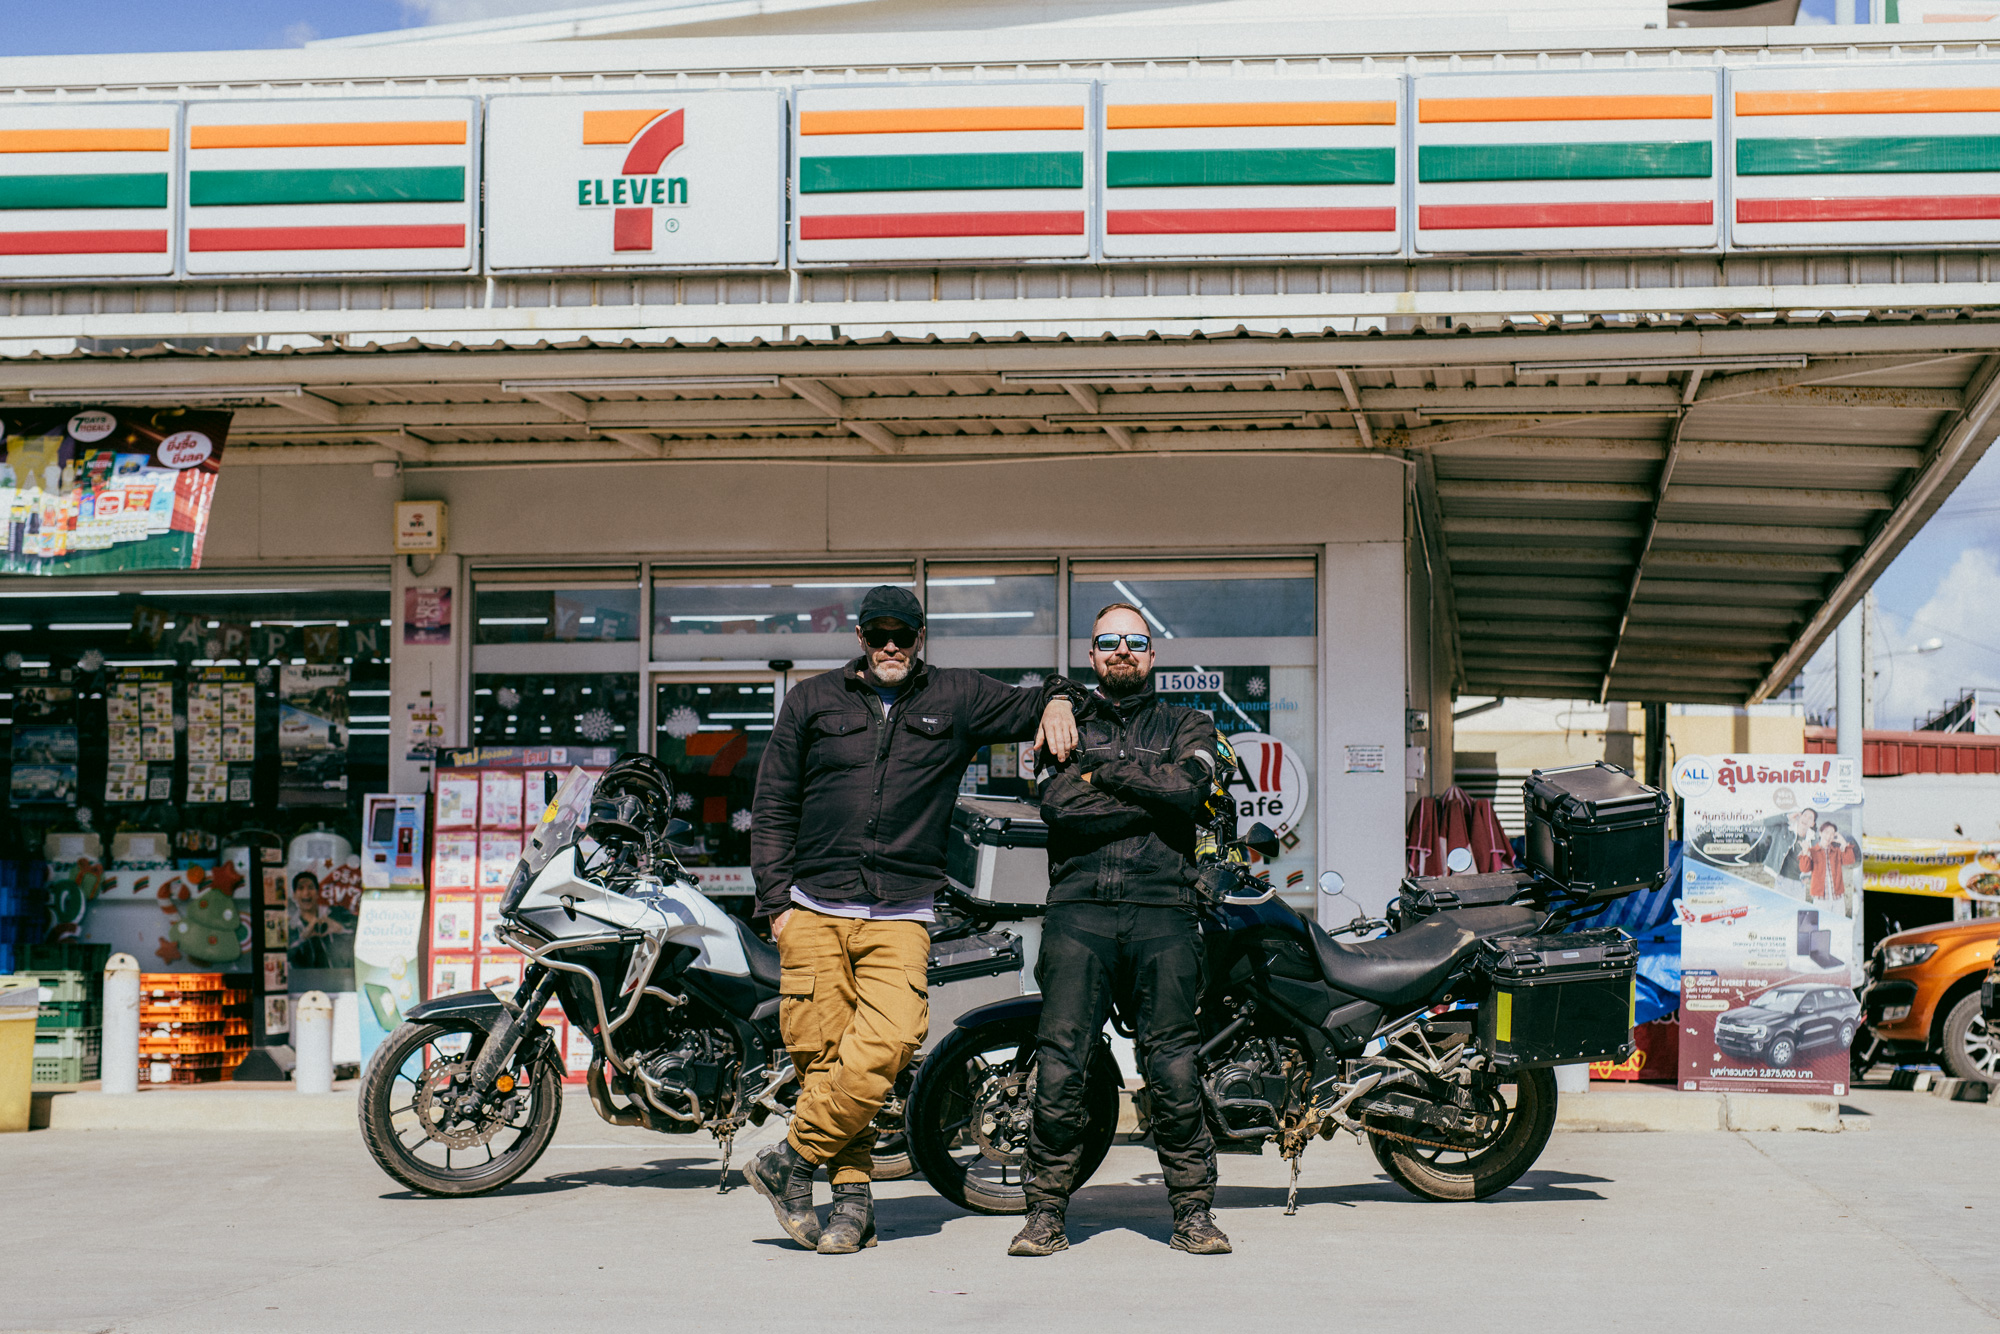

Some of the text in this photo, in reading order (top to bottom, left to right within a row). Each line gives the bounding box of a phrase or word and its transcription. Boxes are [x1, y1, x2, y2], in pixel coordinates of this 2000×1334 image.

[583, 108, 684, 251] 7
[1159, 674, 1221, 691] 15089
[1681, 768, 1709, 780] ALL
[1717, 758, 1831, 793] ลุ้นจัดเต็ม!
[1237, 793, 1284, 817] afé
[1711, 906, 1748, 919] airasia.com
[1721, 979, 1746, 987] EVEREST
[1747, 979, 1768, 987] TREND
[1759, 1069, 1796, 1079] 2,875,900
[1797, 1070, 1813, 1079] บาท
